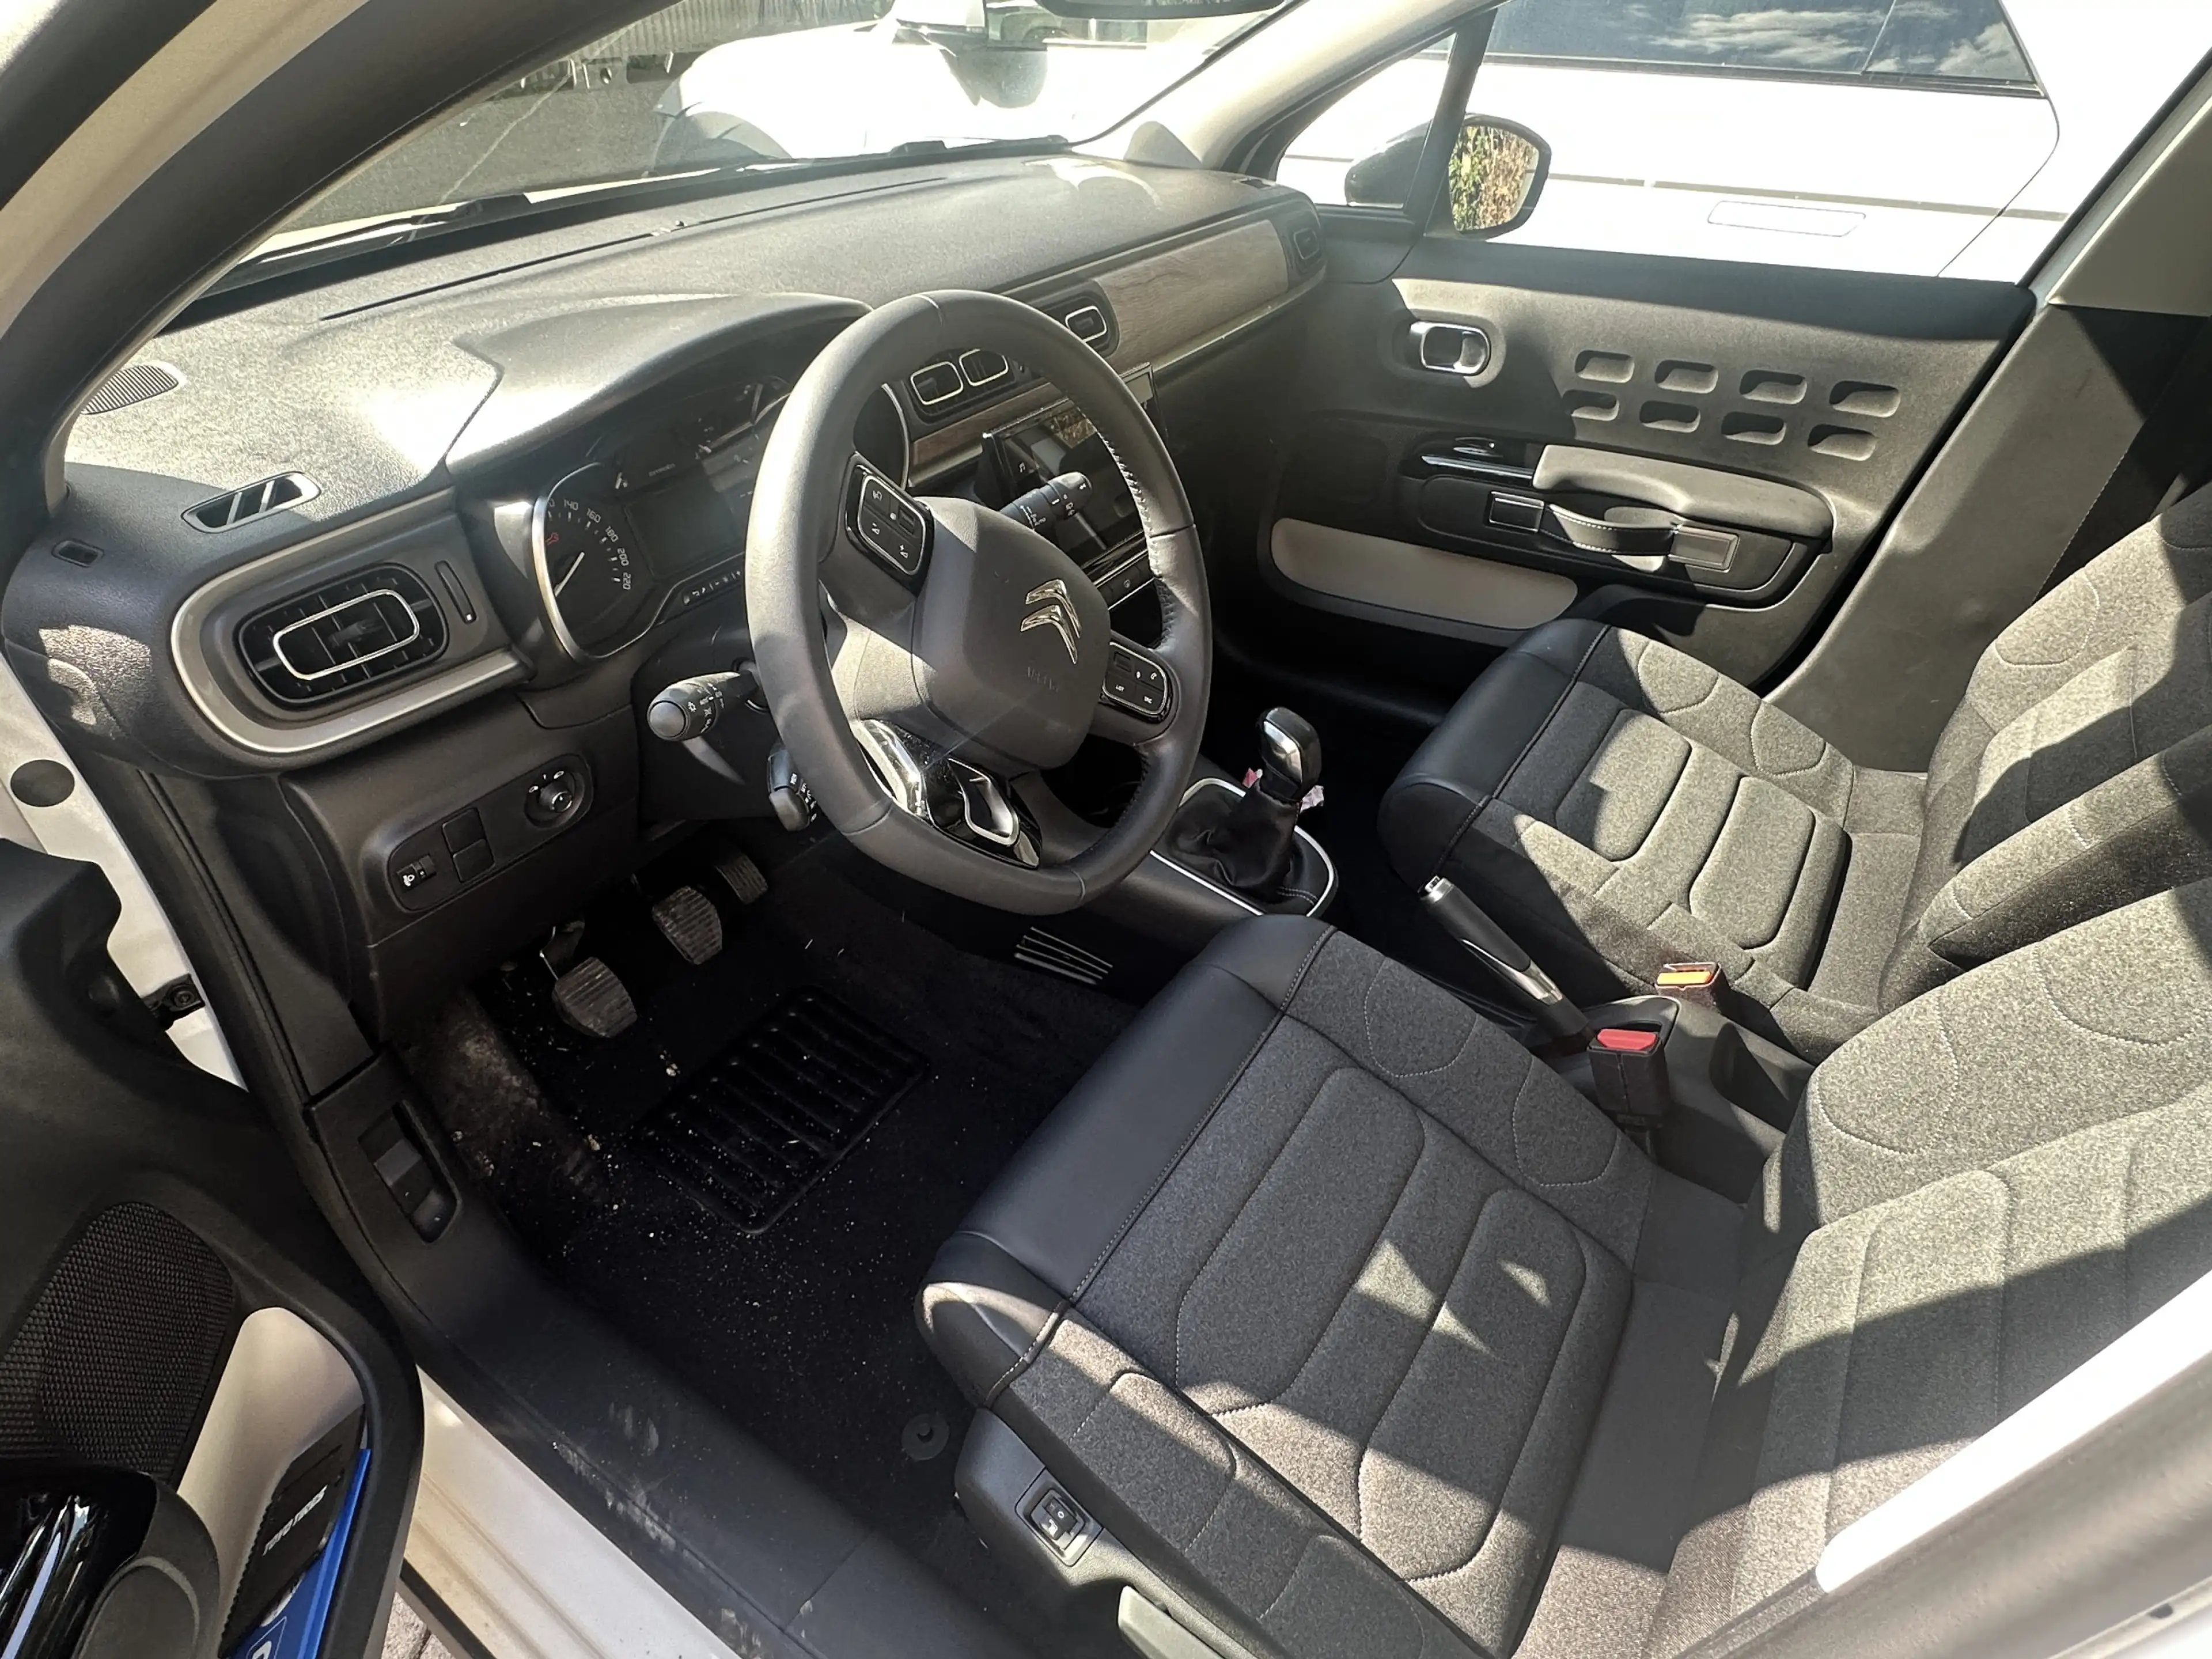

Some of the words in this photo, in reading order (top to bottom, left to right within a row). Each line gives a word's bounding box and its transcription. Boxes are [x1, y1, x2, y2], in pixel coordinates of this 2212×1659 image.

[563, 498, 579, 510] 140
[586, 507, 601, 523] 160
[605, 525, 619, 542] 180
[617, 548, 629, 566] 200
[622, 572, 631, 590] 220
